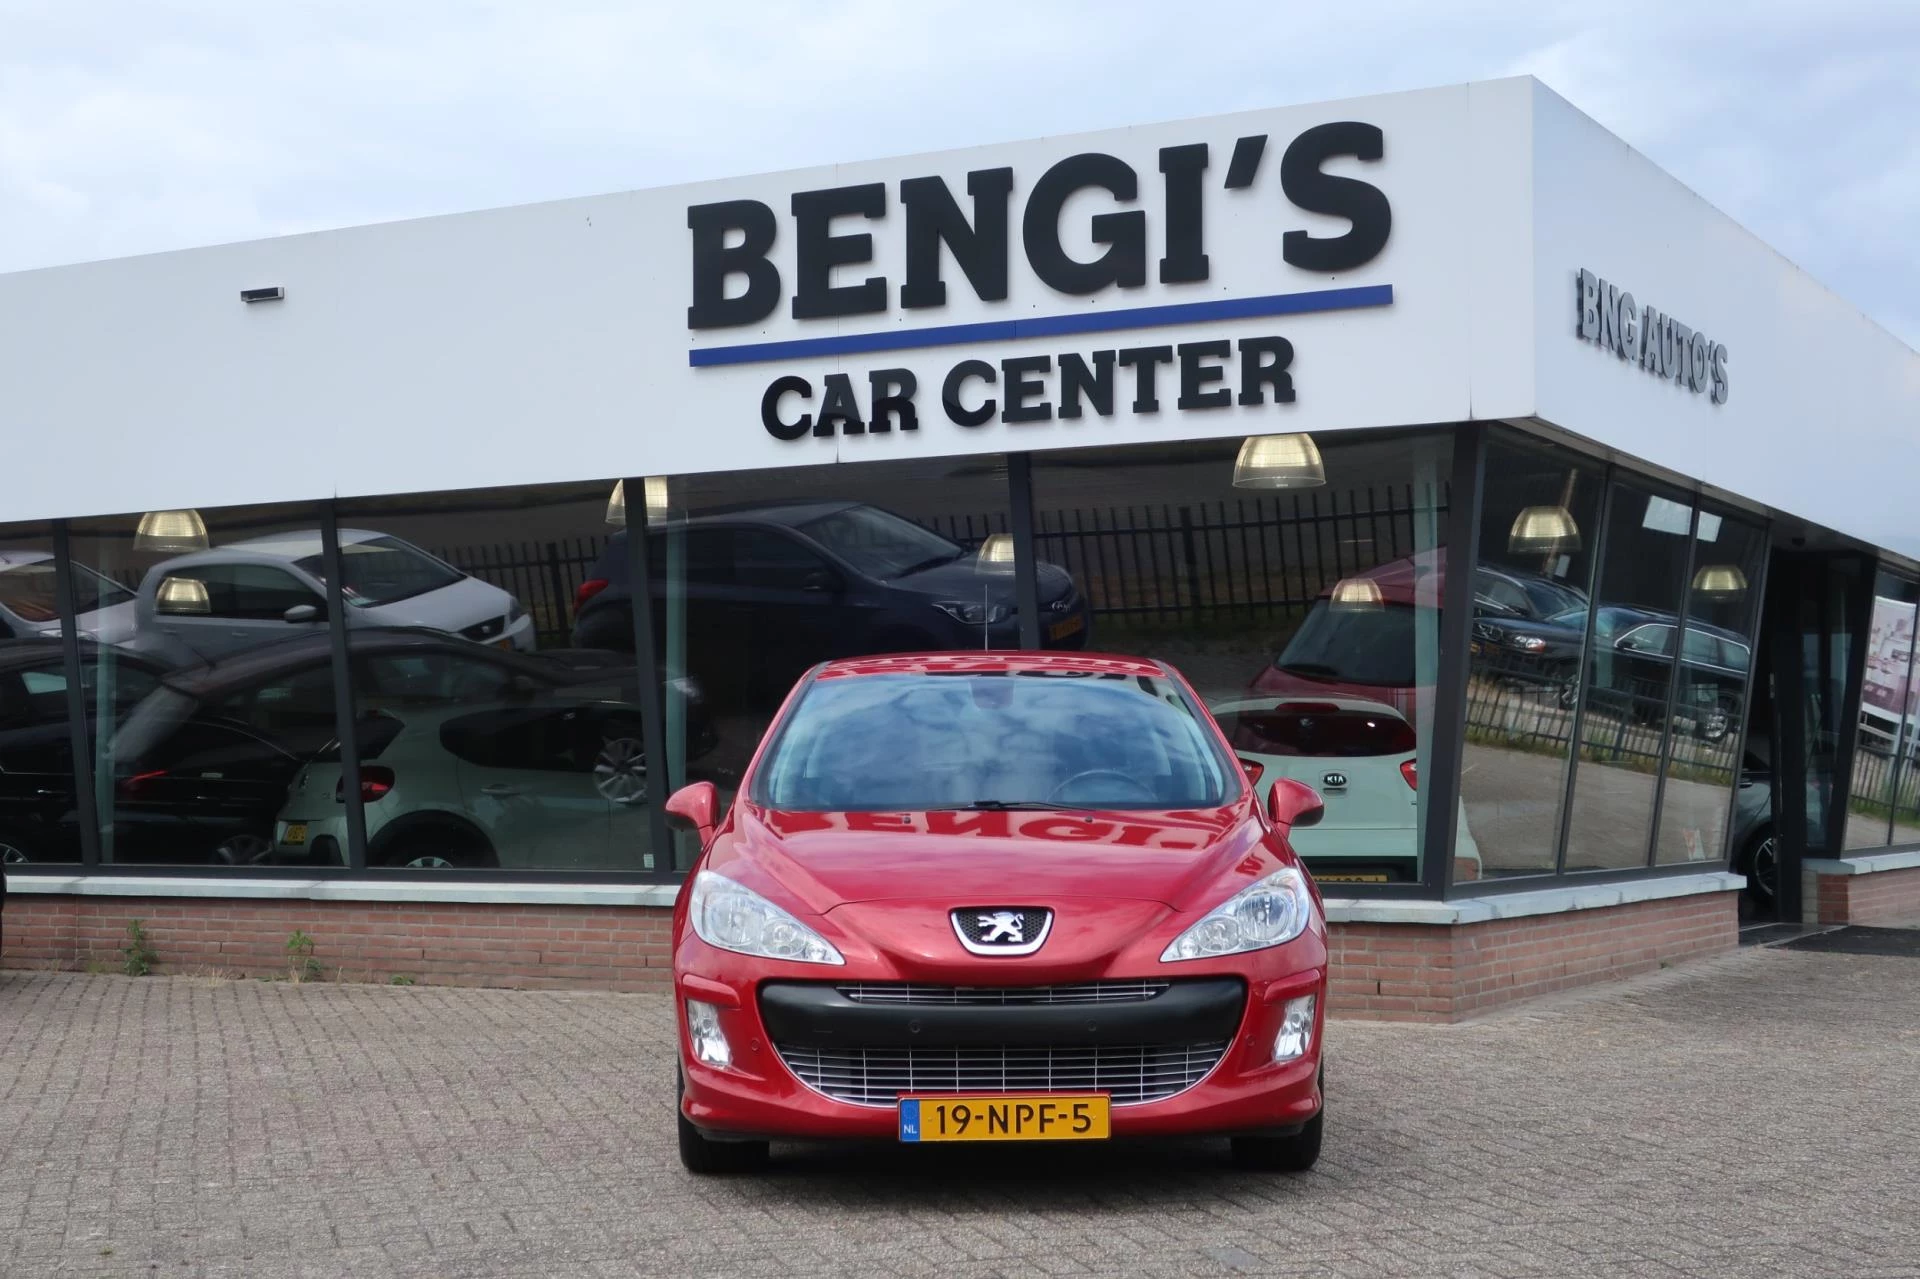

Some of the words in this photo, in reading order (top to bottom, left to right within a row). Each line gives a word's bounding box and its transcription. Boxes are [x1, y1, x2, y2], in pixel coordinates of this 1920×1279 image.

[688, 121, 1392, 329] BENGI'S
[761, 368, 918, 441] CAR
[942, 336, 1296, 428] CENTER
[1576, 267, 1638, 361] BNG
[1640, 305, 1728, 405] AUTO'S
[1326, 775, 1345, 784] KIA
[903, 1124, 917, 1134] NL
[936, 1103, 1092, 1135] 19-NPF-5
